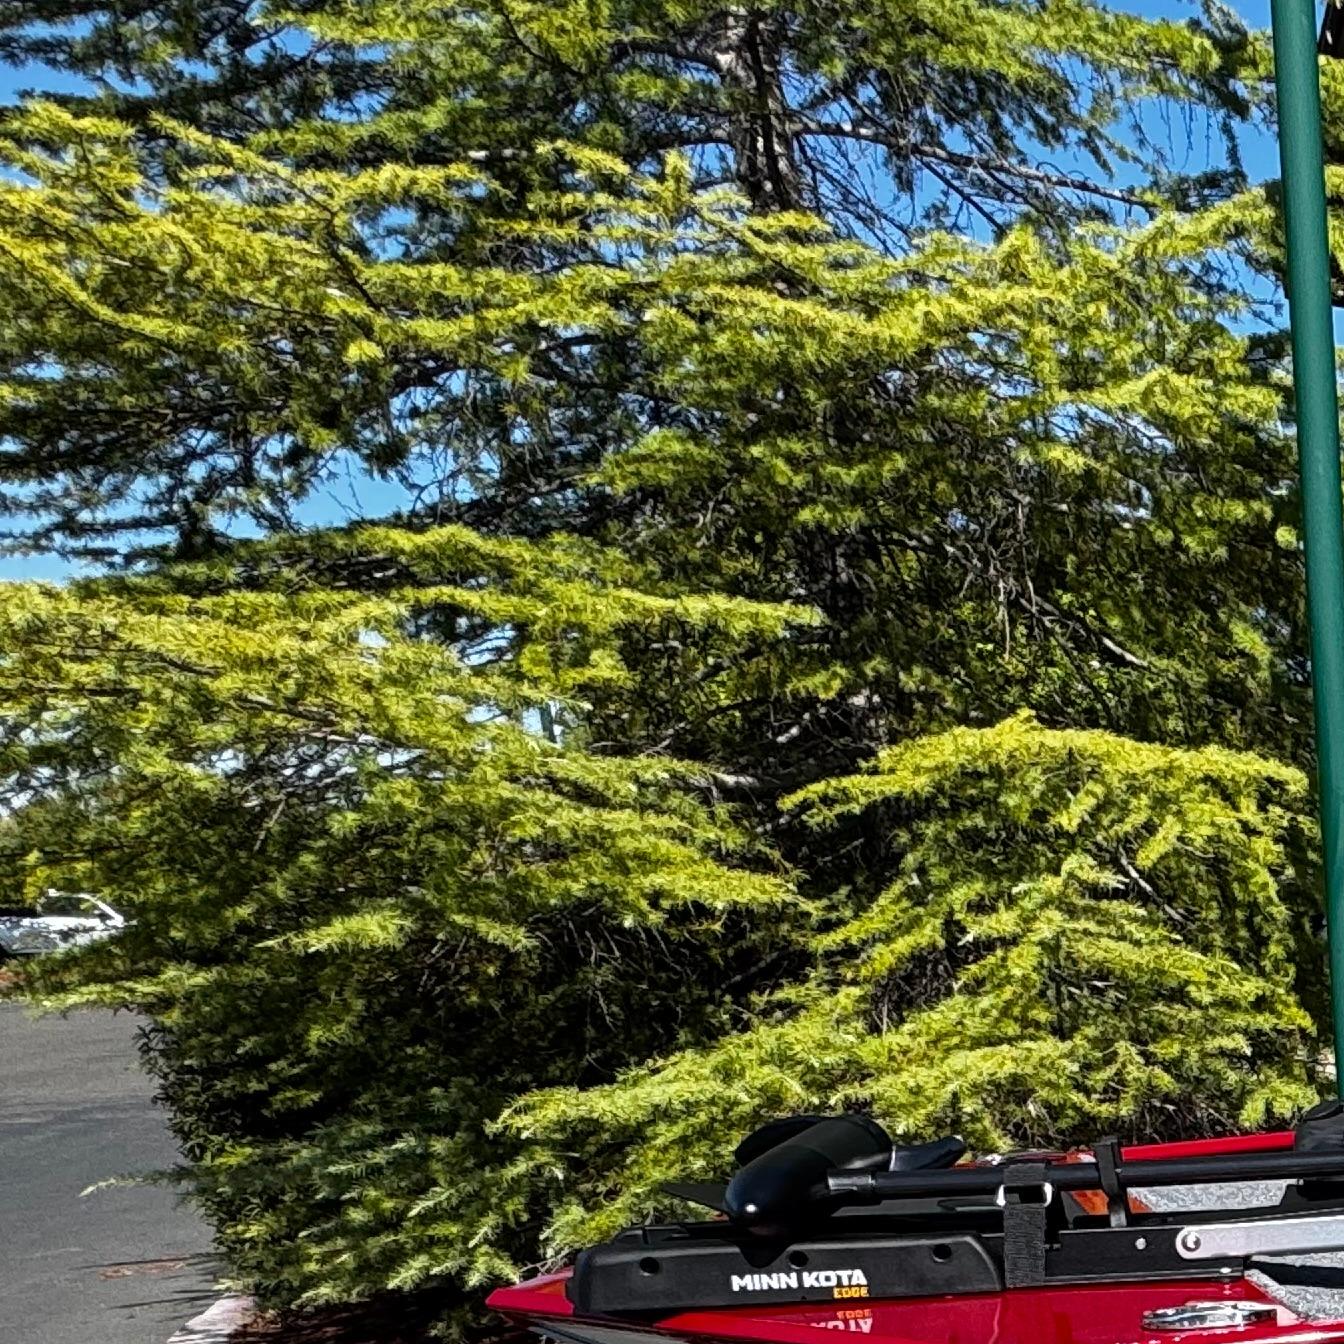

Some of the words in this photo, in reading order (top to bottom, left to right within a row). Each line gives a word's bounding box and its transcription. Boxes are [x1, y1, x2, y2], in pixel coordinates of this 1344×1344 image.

[731, 1273, 799, 1292] MINN
[803, 1269, 868, 1288] KOTA
[833, 1286, 870, 1299] EDGE
